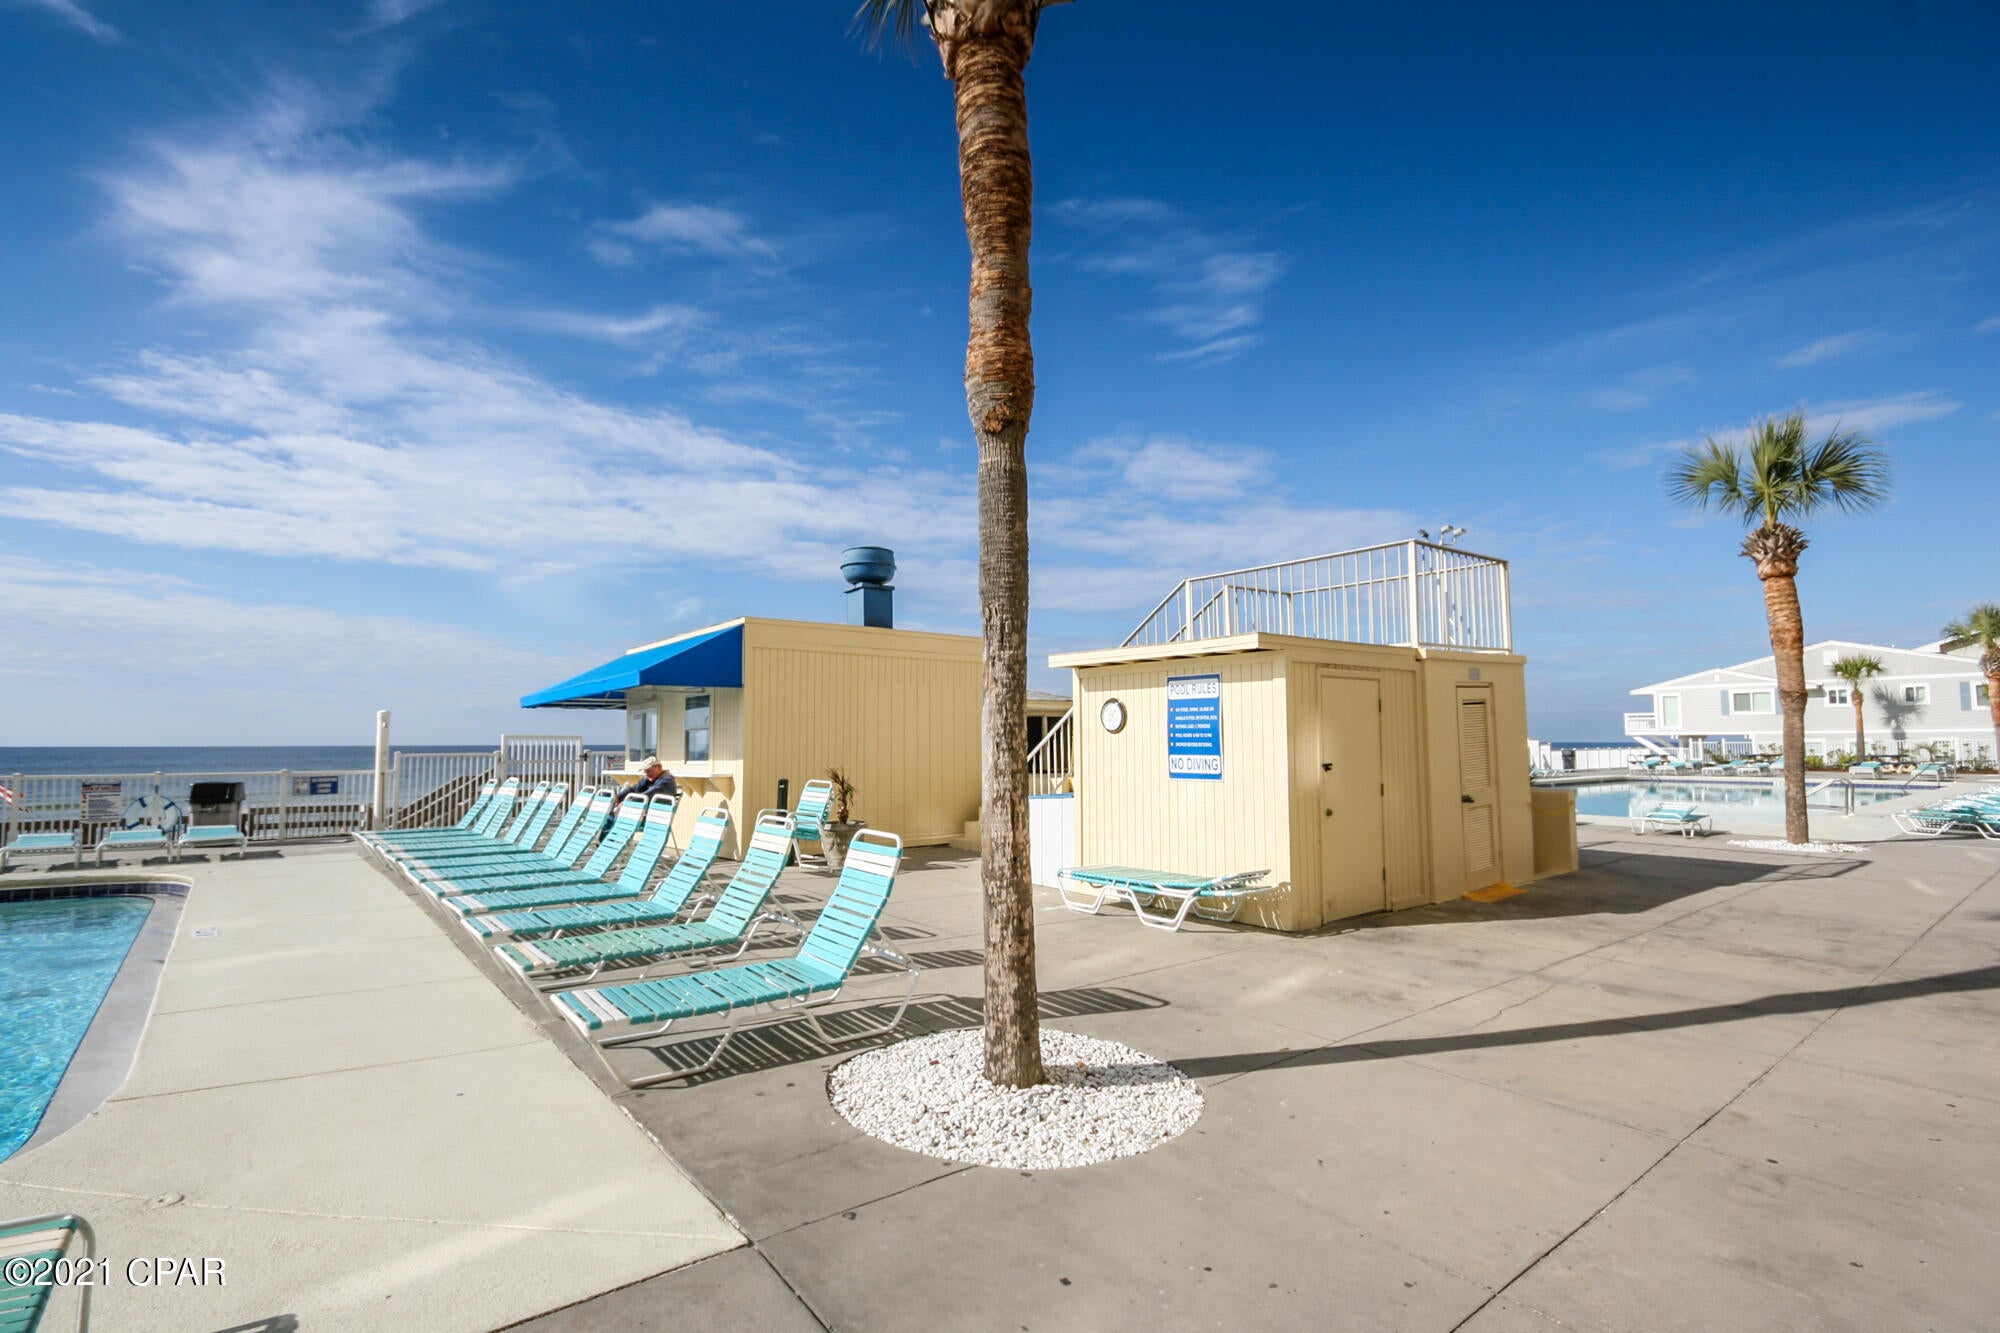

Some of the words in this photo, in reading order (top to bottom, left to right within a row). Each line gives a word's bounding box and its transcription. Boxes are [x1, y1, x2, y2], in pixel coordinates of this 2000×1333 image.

[1170, 683, 1190, 695] POOL
[1192, 682, 1217, 695] RULES
[1171, 757, 1184, 770] NO
[1187, 757, 1219, 771] DIVING
